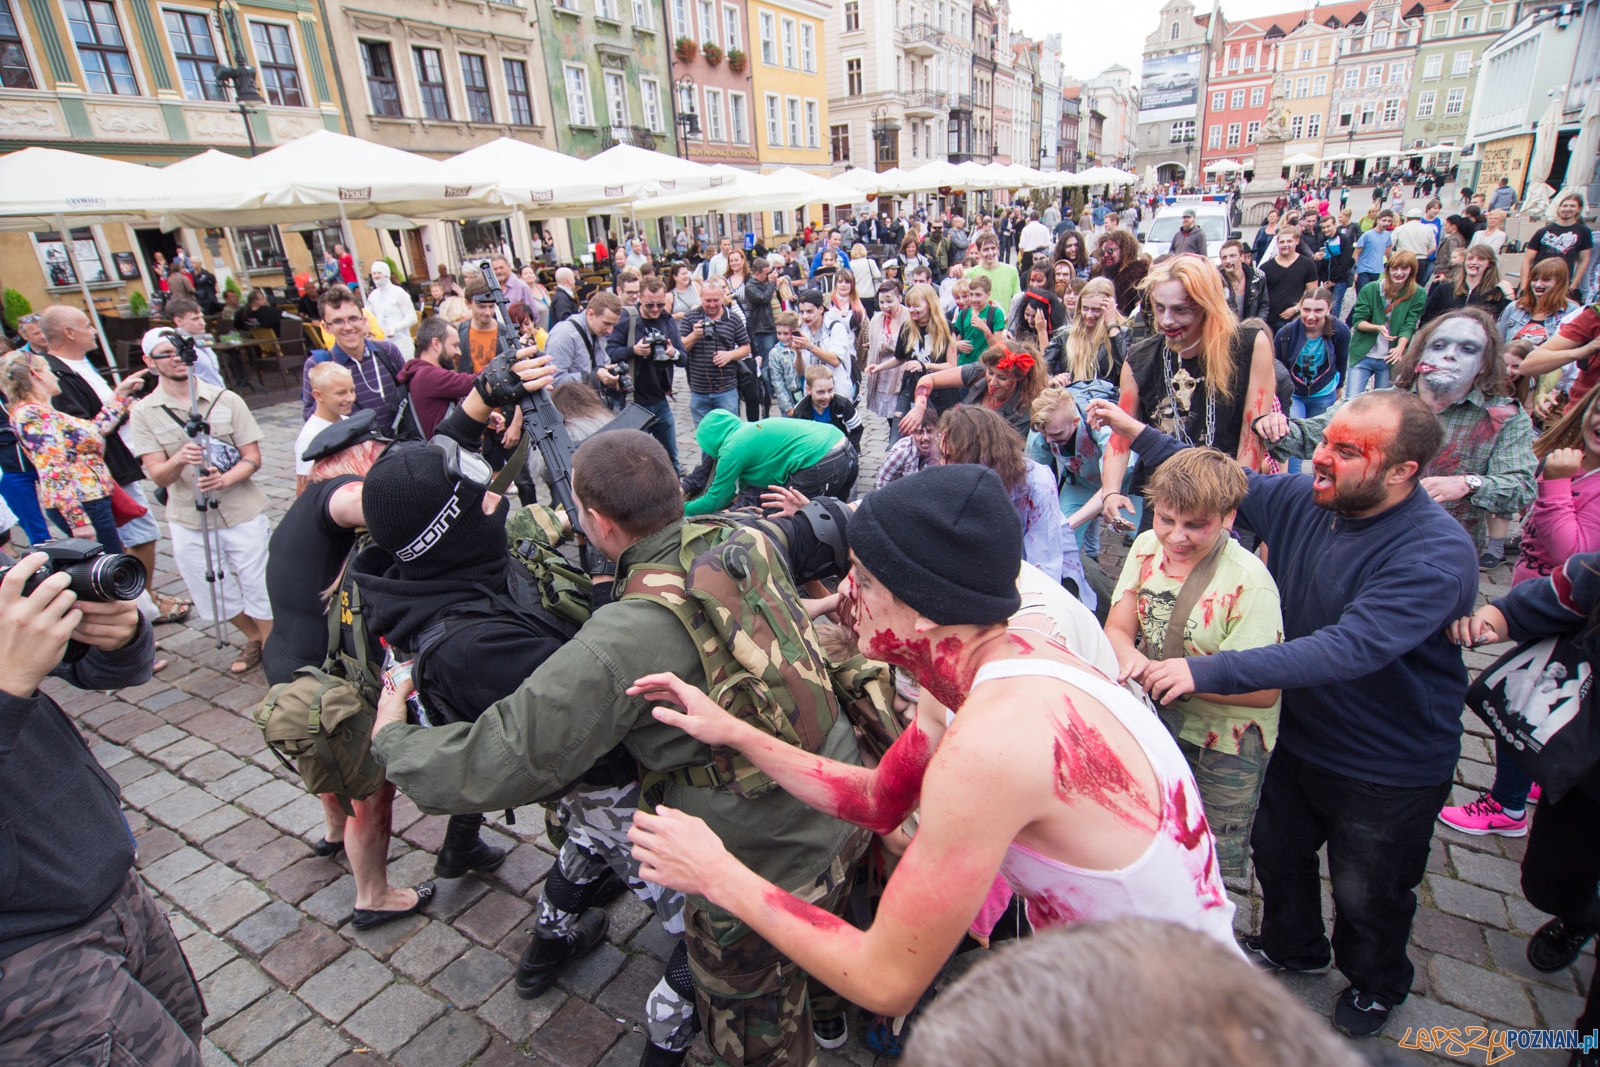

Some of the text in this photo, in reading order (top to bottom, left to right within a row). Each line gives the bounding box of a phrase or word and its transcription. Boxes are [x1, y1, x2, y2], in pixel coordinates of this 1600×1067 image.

[340, 188, 370, 199] TYSKIE
[446, 187, 469, 197] TYSKIE
[532, 190, 552, 200] TYSKIE
[606, 186, 623, 195] TYSKIE
[395, 494, 461, 562] SCOTT
